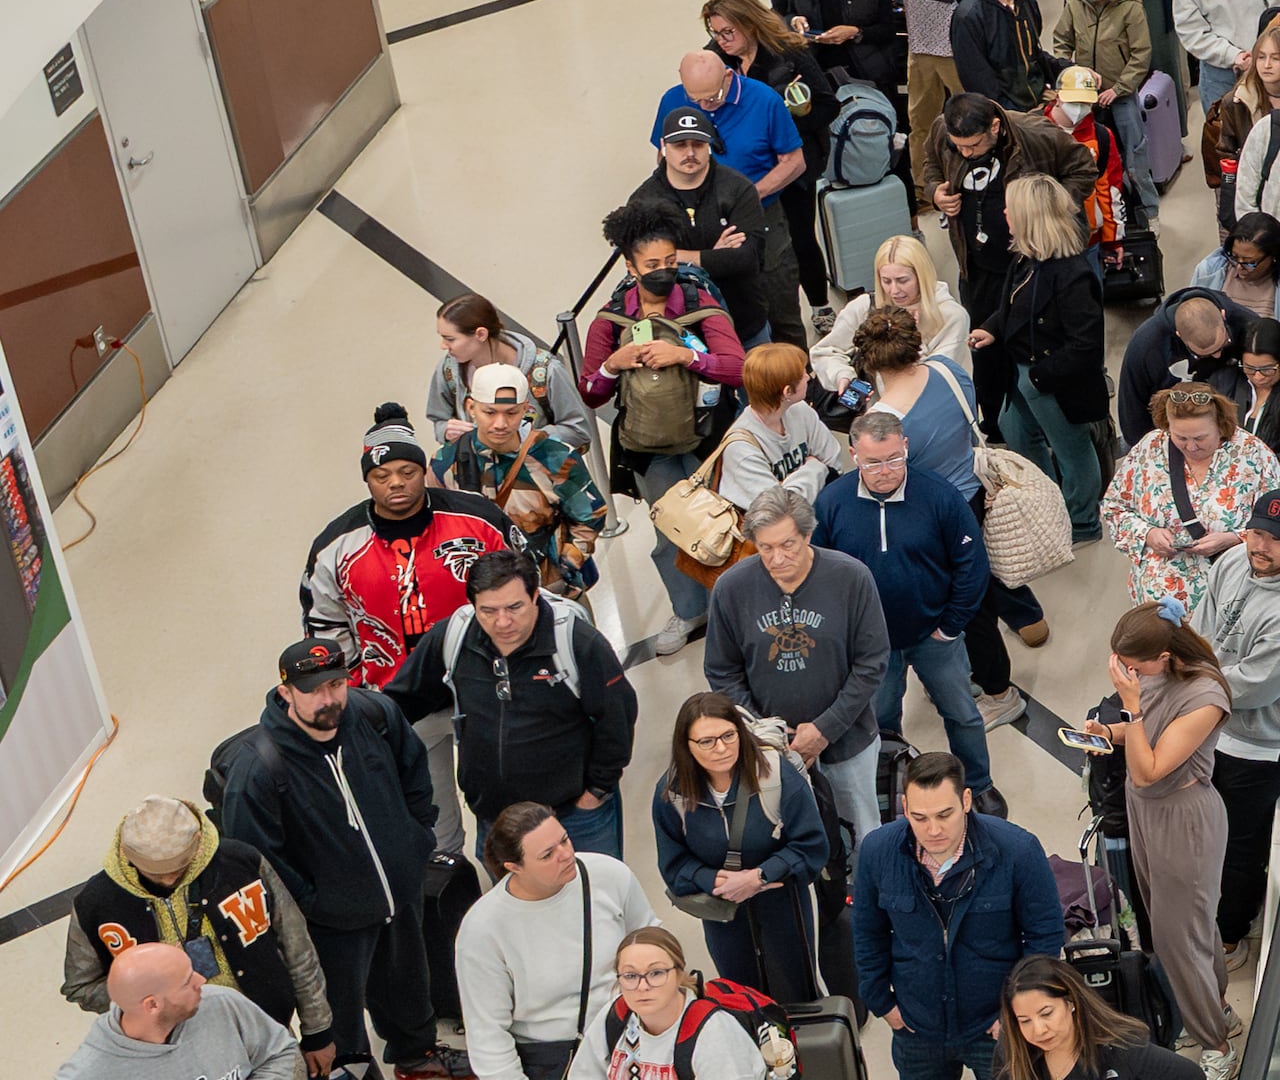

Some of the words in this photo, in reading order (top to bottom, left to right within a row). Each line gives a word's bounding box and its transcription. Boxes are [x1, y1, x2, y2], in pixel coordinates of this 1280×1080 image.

[757, 611, 780, 632] LIFE
[793, 608, 823, 628] GOOD
[777, 658, 806, 672] SLOW
[218, 879, 272, 948] W
